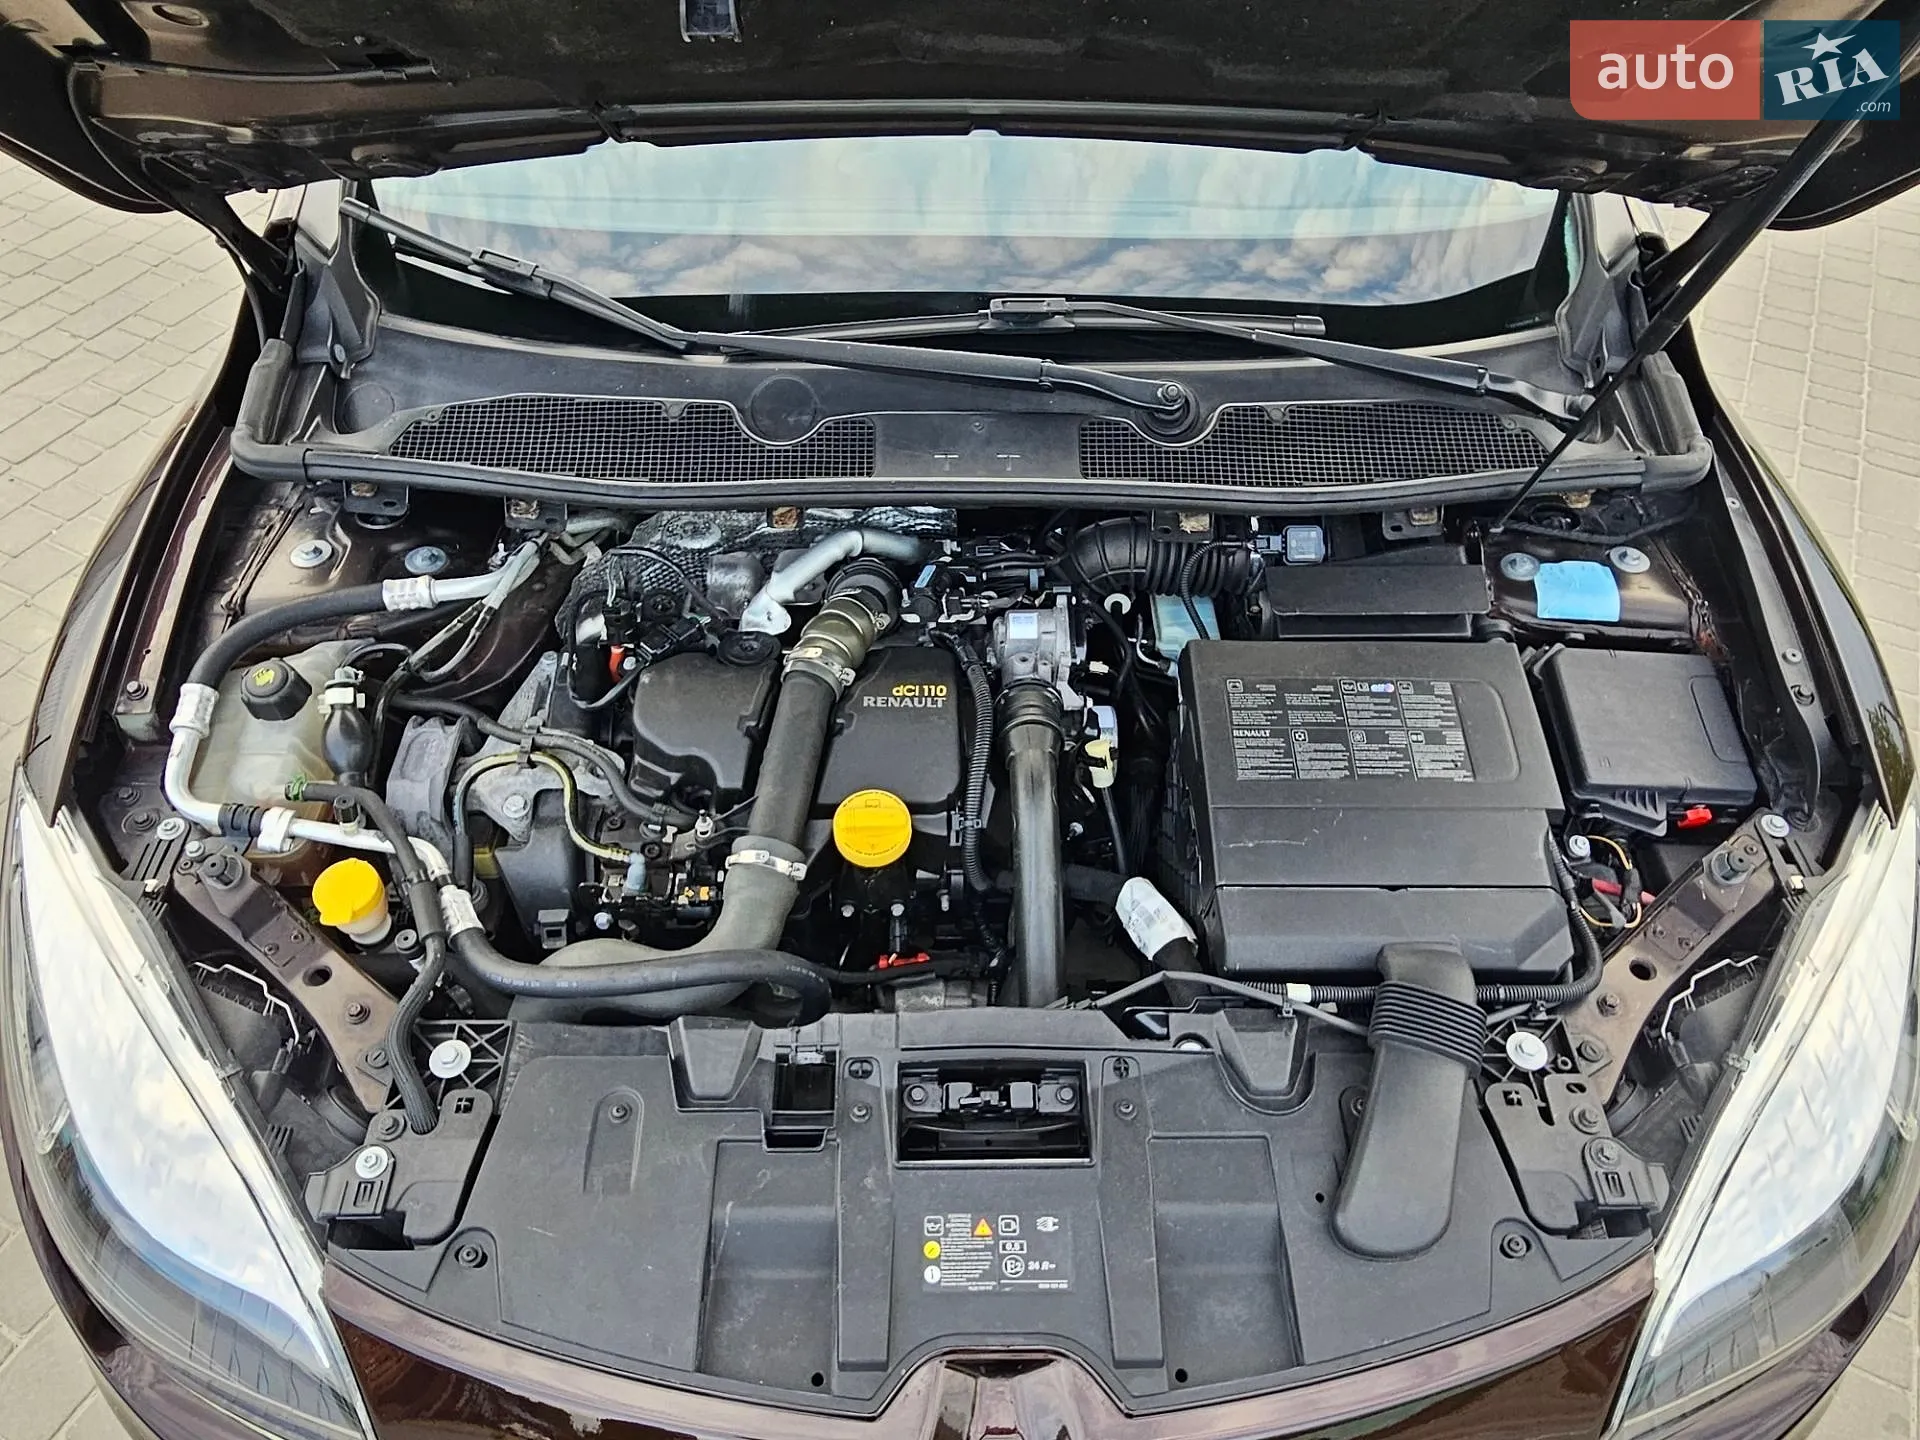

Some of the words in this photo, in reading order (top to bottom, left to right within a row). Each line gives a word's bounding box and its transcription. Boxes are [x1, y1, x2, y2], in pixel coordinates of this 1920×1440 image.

[922, 684, 947, 697] 110
[863, 695, 947, 708] RENAULT
[1232, 729, 1271, 738] RENAULT
